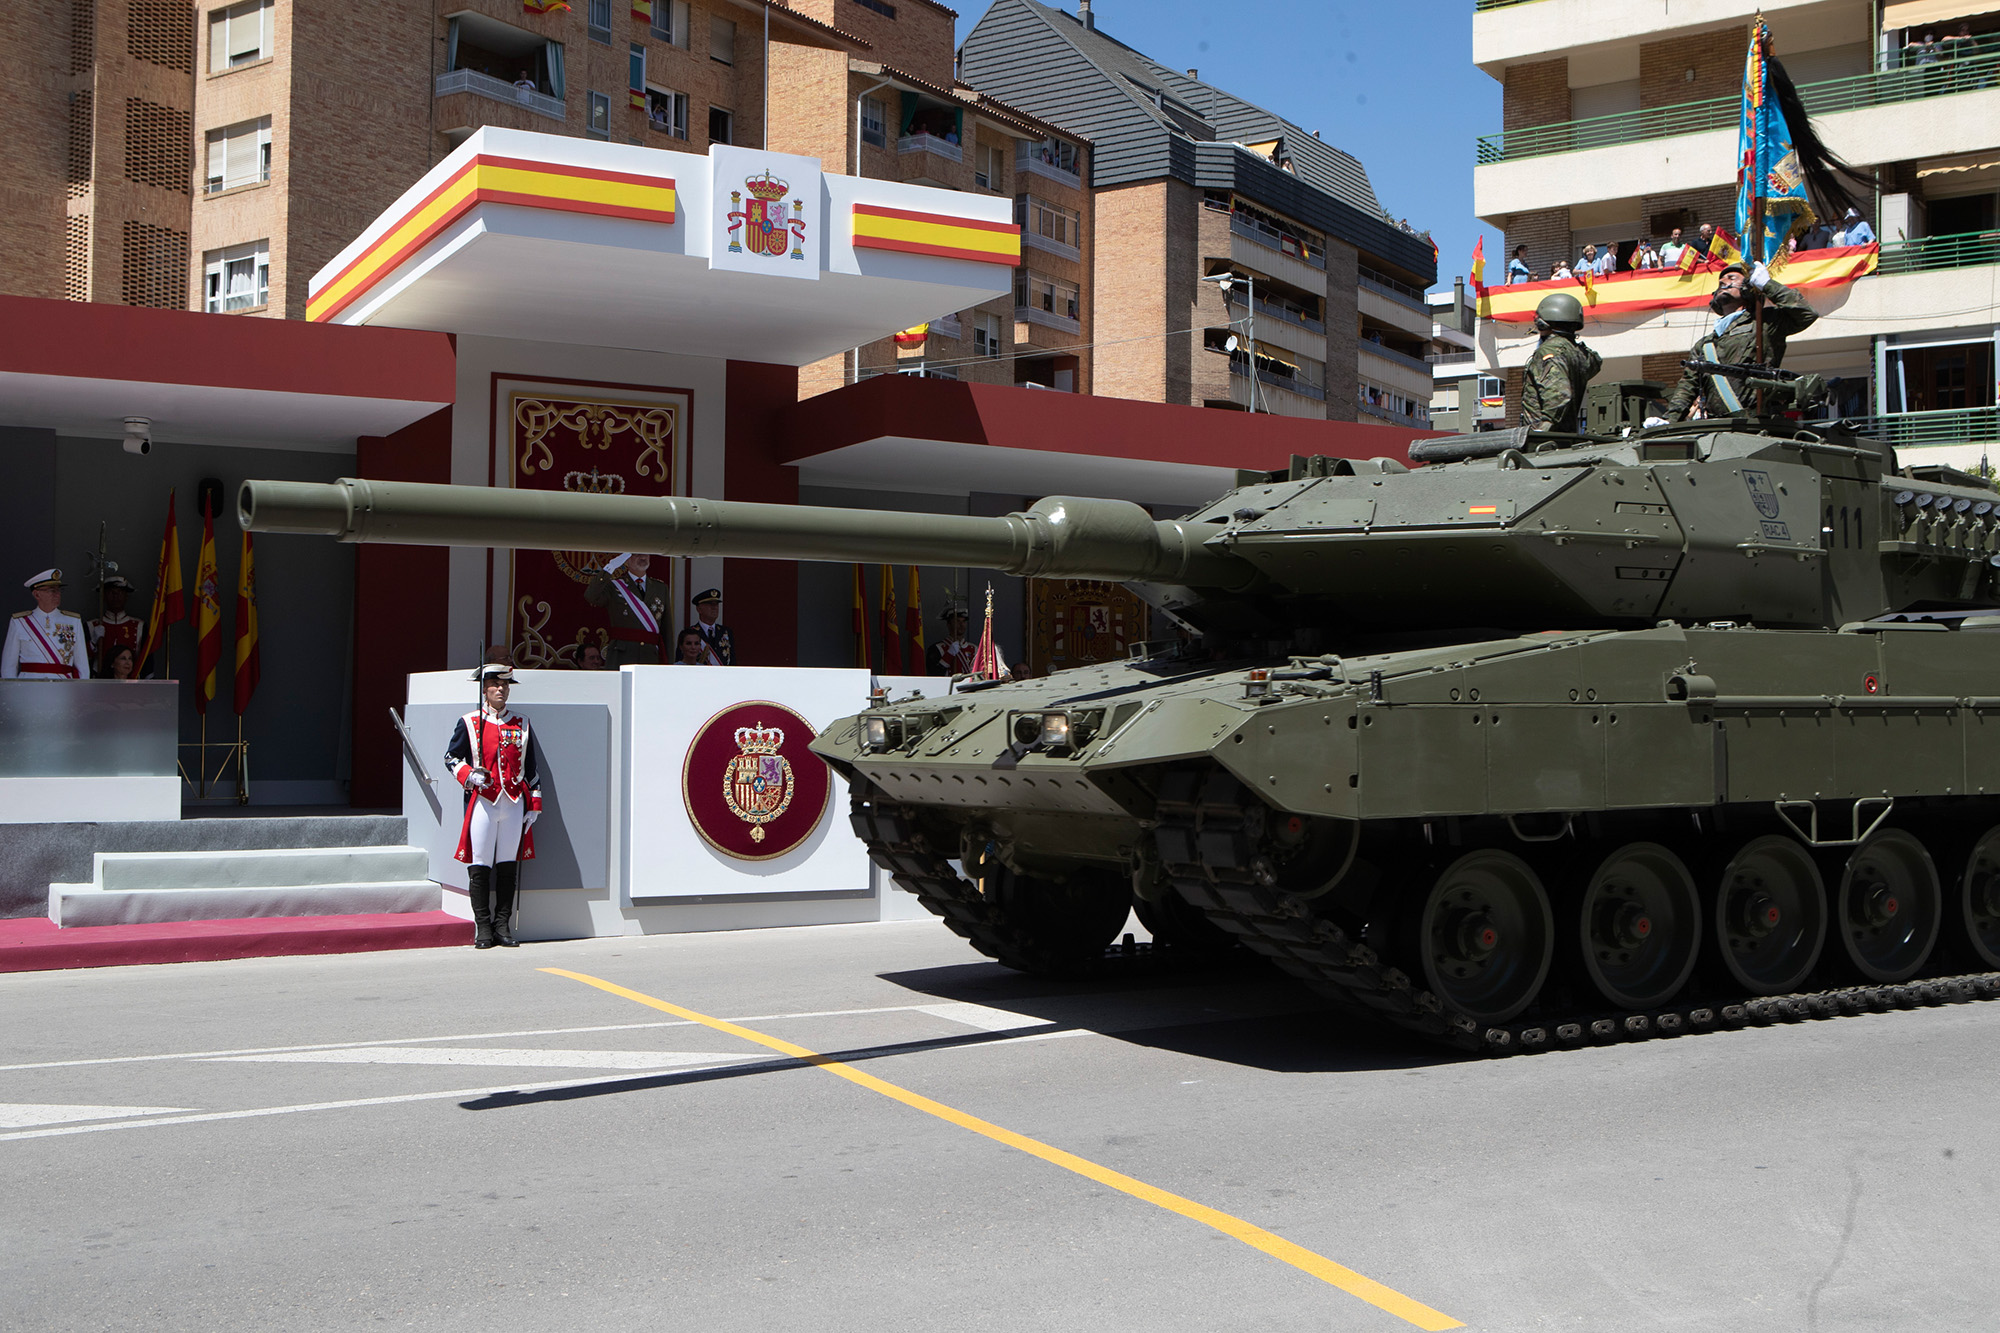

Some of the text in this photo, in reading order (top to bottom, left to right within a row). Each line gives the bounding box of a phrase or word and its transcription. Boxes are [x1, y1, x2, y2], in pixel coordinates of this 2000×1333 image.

[1763, 524, 1788, 537] RAC 4
[1825, 504, 1862, 550] 111
